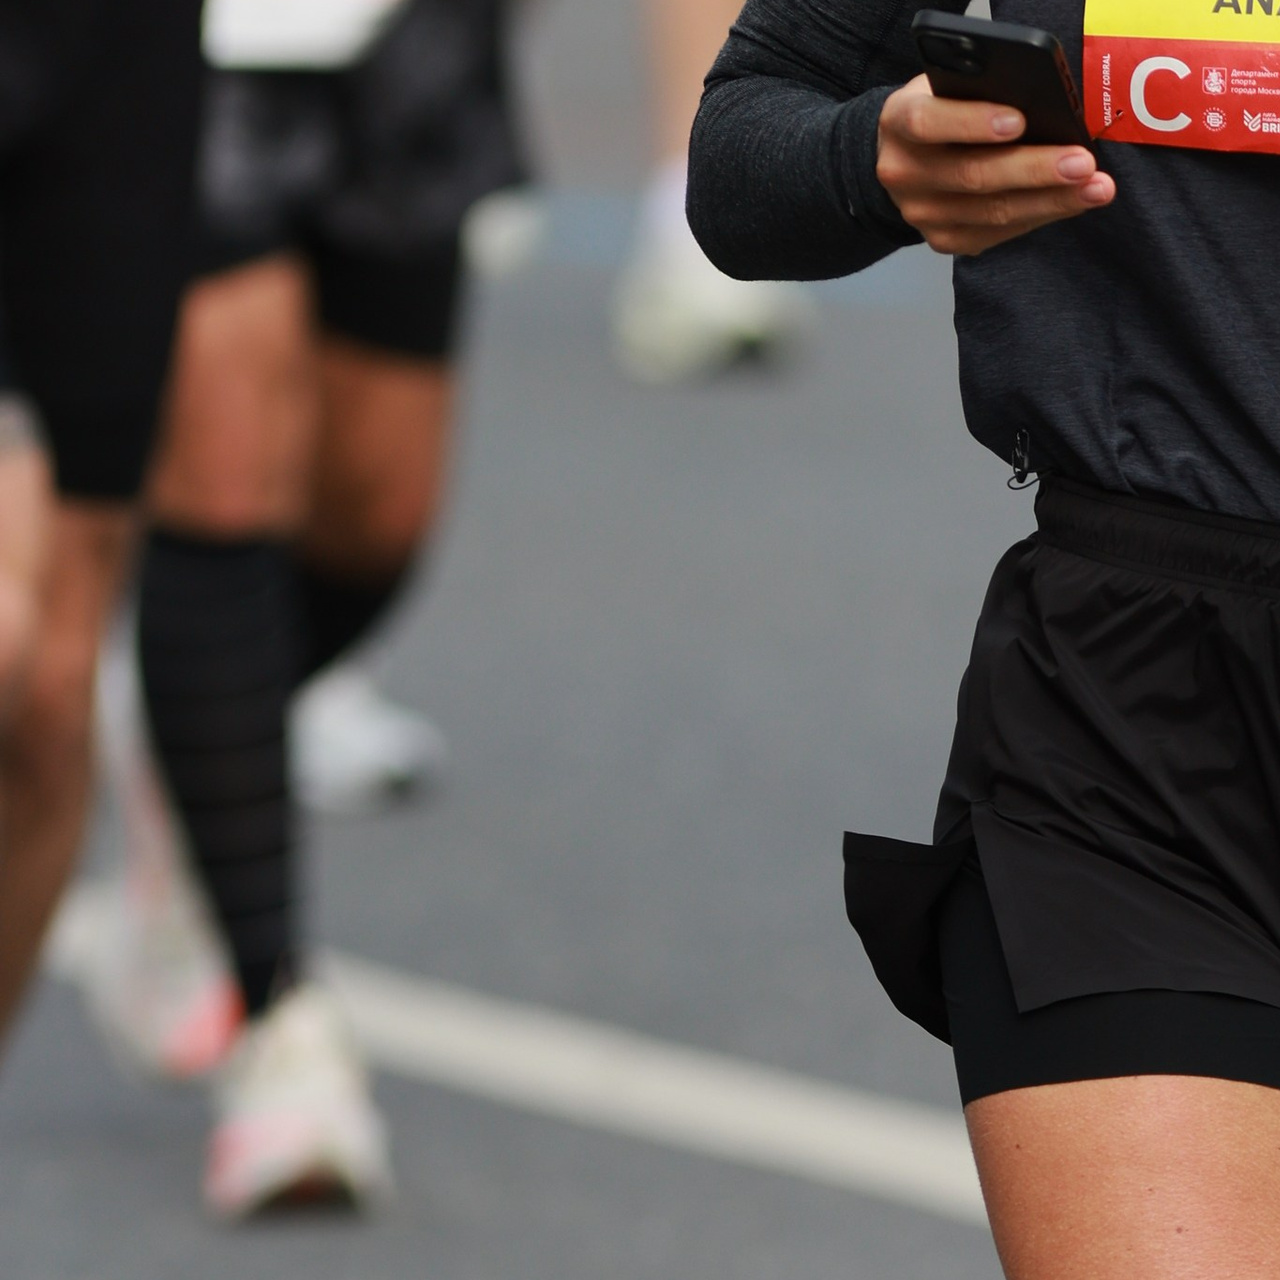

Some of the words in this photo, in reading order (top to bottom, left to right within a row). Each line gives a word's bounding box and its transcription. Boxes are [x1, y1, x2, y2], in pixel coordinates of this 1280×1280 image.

[1103, 53, 1111, 86] CORRAL
[1230, 78, 1257, 86] спорта
[1230, 87, 1256, 95] города
[1130, 56, 1192, 132] C
